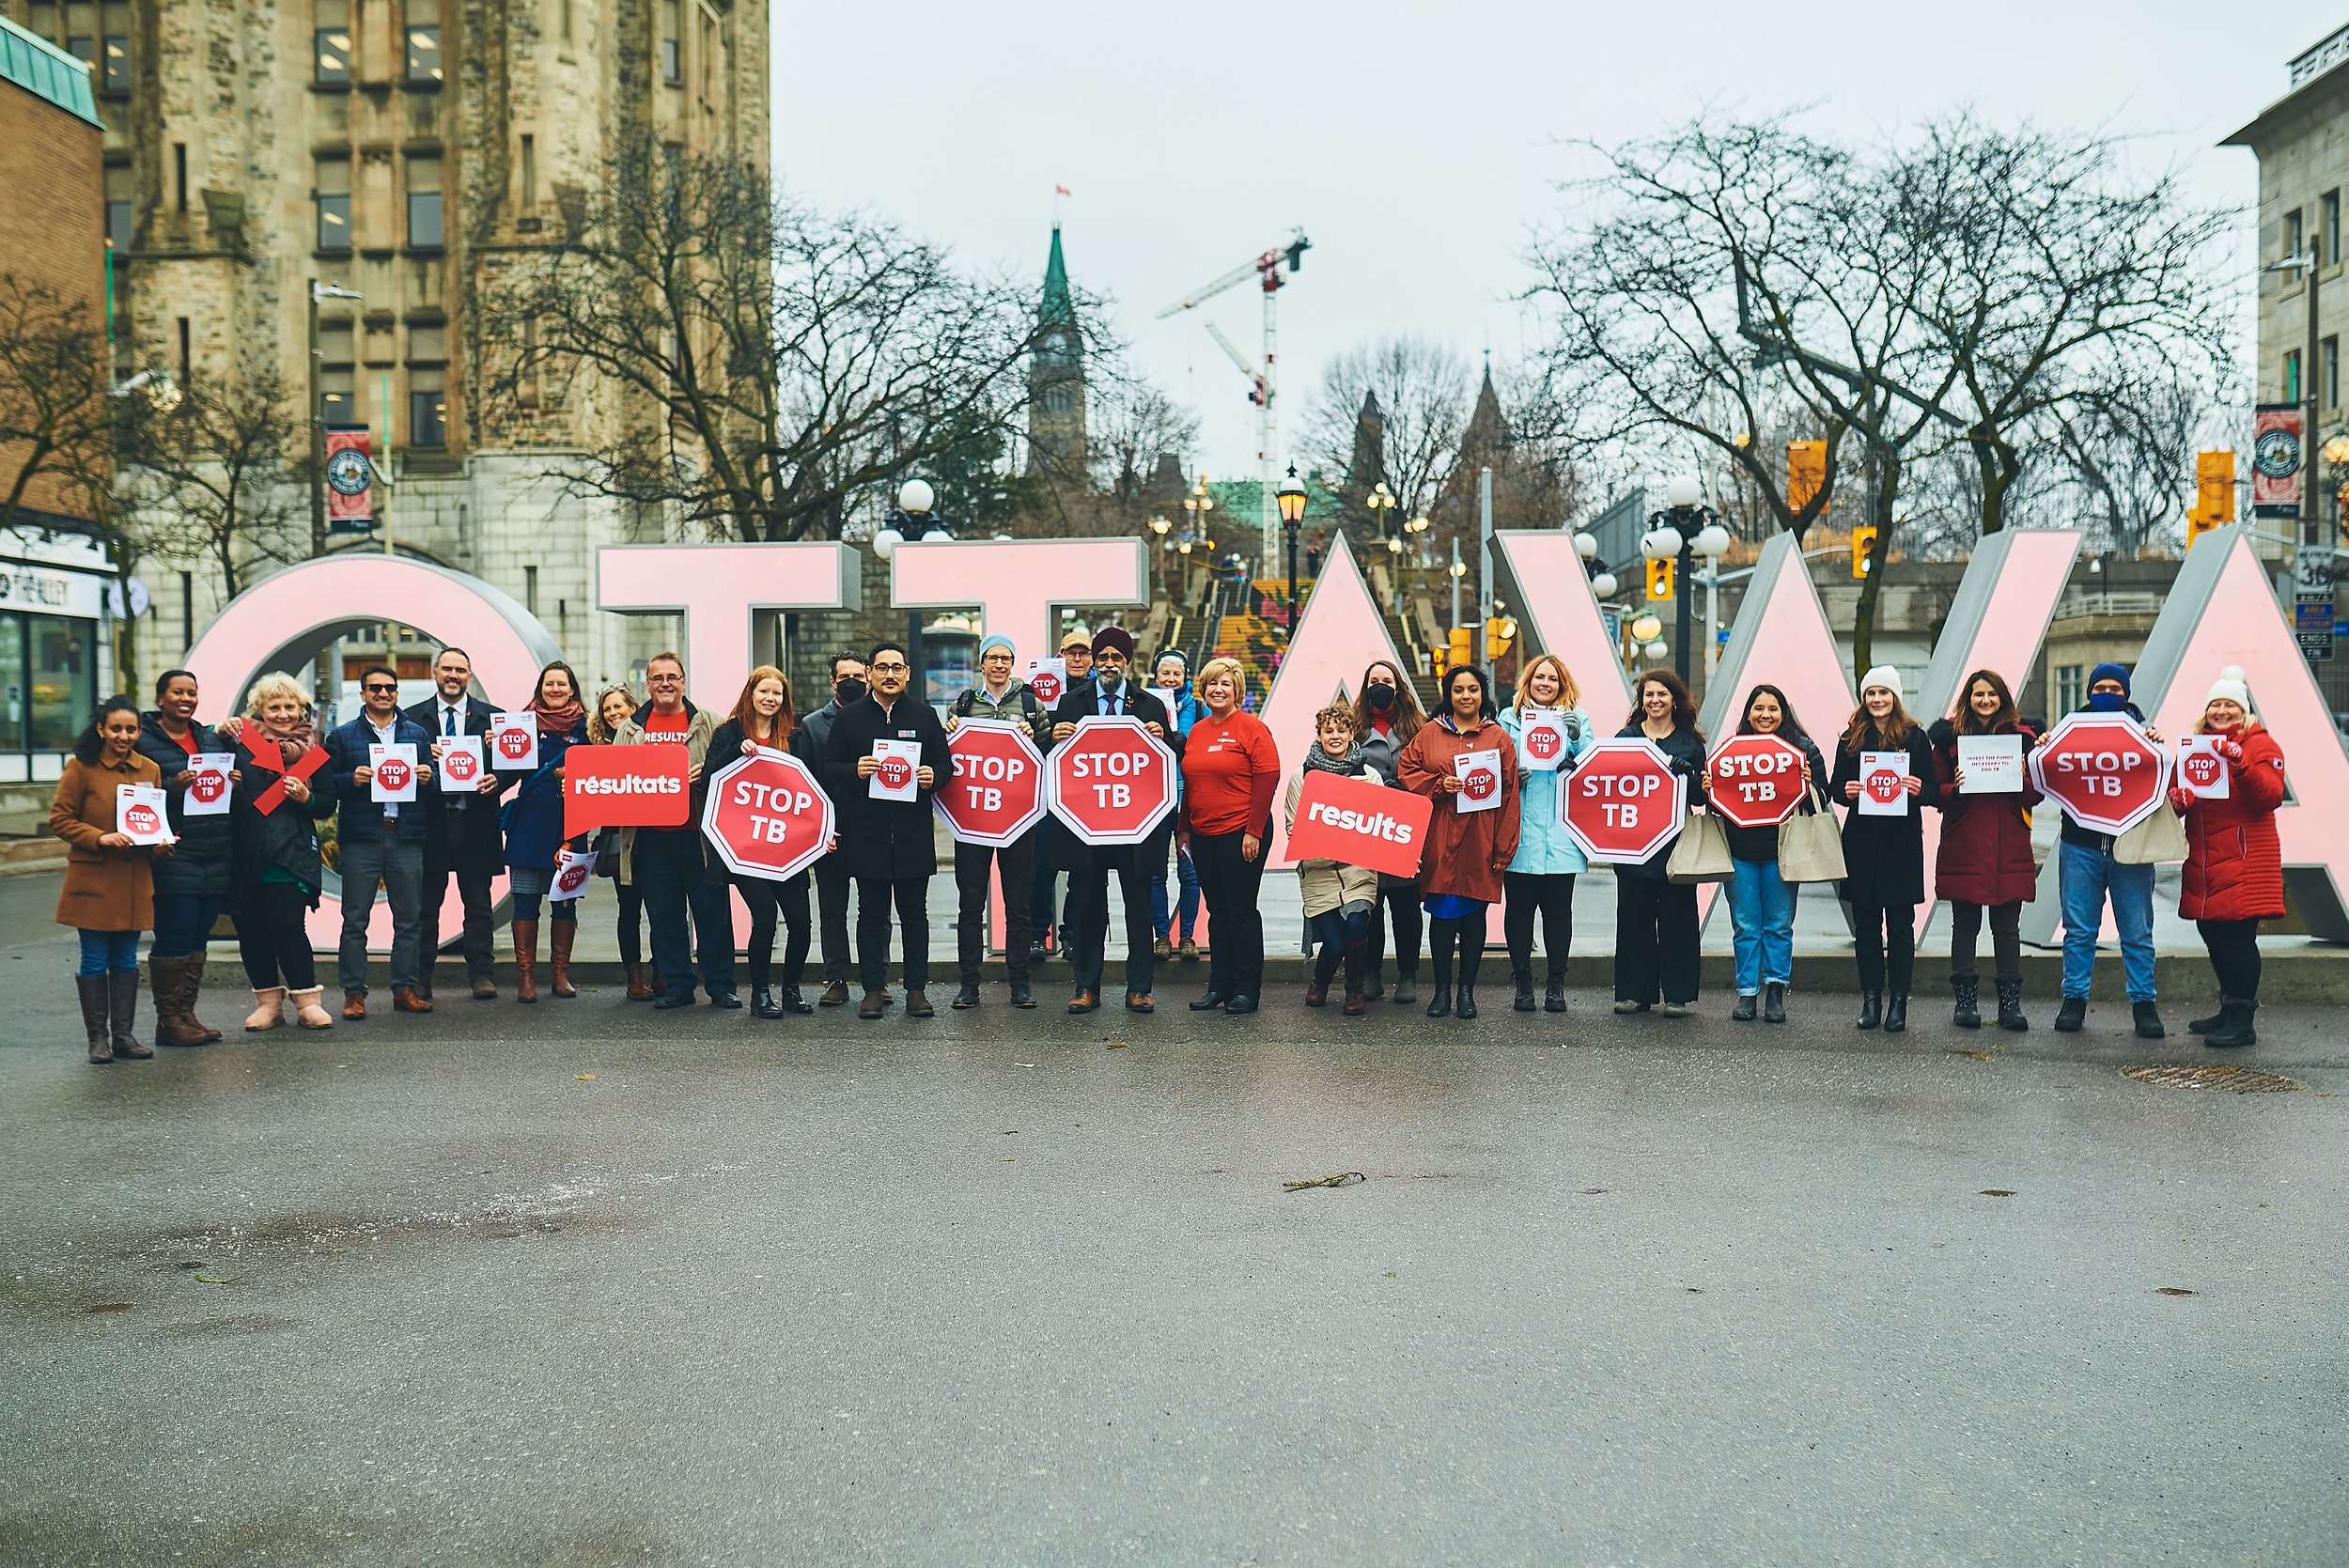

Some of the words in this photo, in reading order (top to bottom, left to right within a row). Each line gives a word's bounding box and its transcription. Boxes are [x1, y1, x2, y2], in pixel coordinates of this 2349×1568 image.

[1033, 678, 1057, 689] STOP
[1039, 688, 1051, 696] TB
[502, 734, 528, 744] STOP
[1531, 732, 1557, 744] STOP
[508, 743, 521, 753] TB
[1536, 743, 1549, 753] TB
[448, 756, 474, 768] STOP
[951, 753, 1024, 782] STOP
[1073, 753, 1149, 777] STOP
[1719, 752, 1794, 777] STOP
[2057, 752, 2141, 772] STOP
[2188, 759, 2216, 769] STOP
[381, 765, 408, 775] STOP
[454, 766, 469, 776] TB
[881, 763, 909, 774] STOP
[196, 776, 222, 786] STOP
[387, 775, 400, 784] TB
[887, 773, 901, 783] TB
[1467, 773, 1491, 787] STOP
[2195, 769, 2210, 781] TB
[576, 774, 680, 794] résultats
[1583, 775, 1659, 797] STOP
[1871, 776, 1898, 787] STOP
[2081, 777, 2121, 797] TB
[201, 786, 214, 797] TB
[1093, 784, 1130, 807] TB
[1473, 784, 1486, 795] TB
[1739, 782, 1776, 802] TB
[1876, 786, 1890, 798] TB
[734, 780, 814, 817] STOP
[967, 786, 1001, 811] TB
[129, 811, 157, 823] STOP
[1602, 804, 1638, 828] TB
[134, 821, 152, 831] TB
[750, 815, 786, 843] TB
[1309, 802, 1412, 844] results
